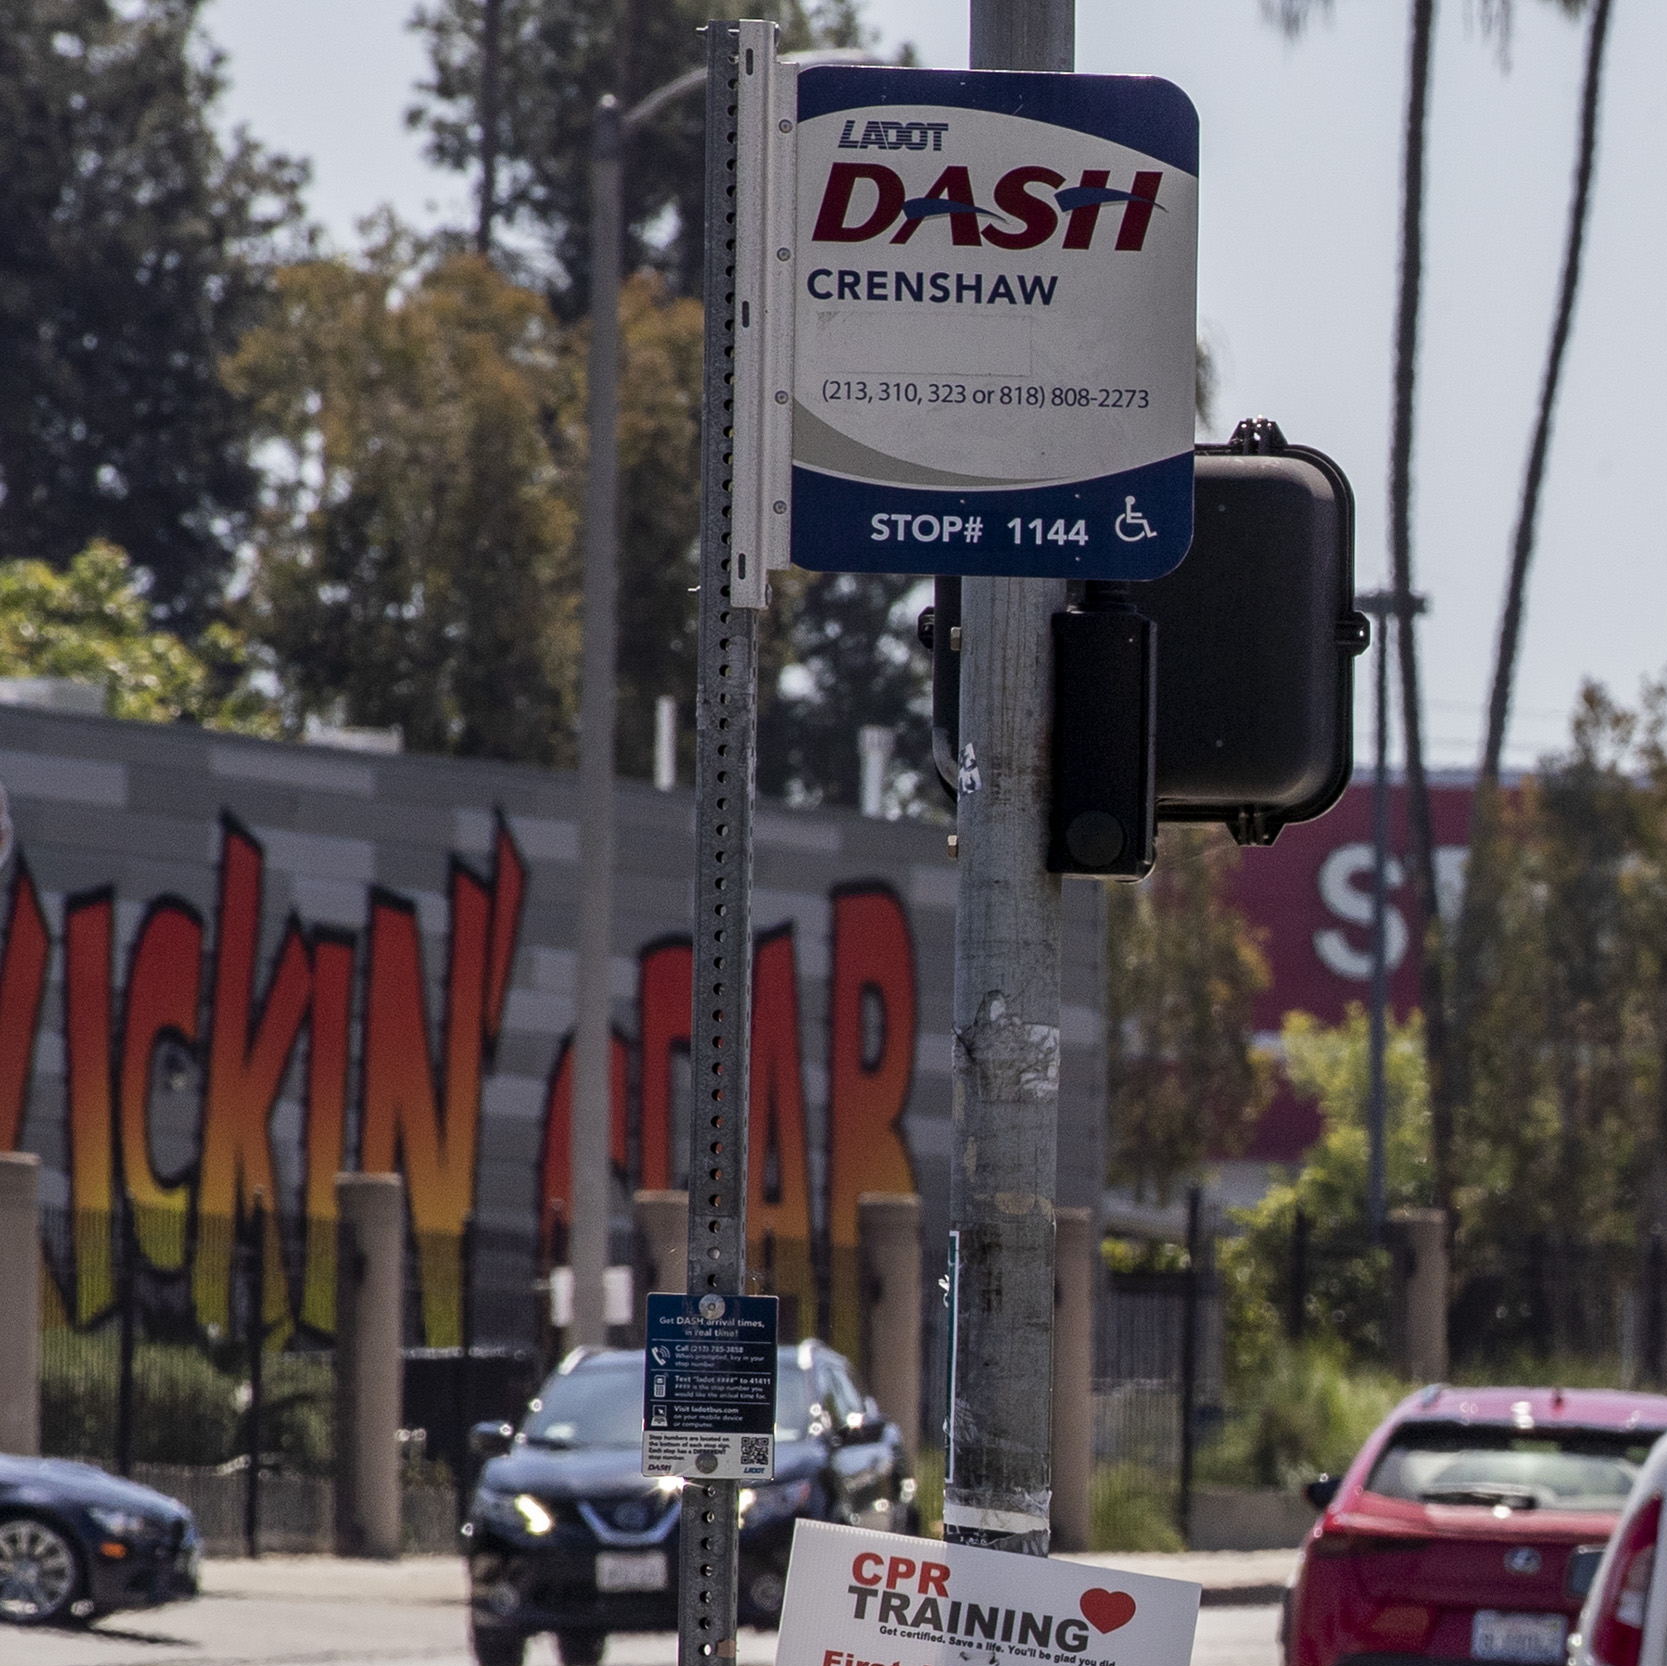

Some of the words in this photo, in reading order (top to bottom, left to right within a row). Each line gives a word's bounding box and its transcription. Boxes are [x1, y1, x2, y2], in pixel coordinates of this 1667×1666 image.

[838, 120, 949, 152] LADOT
[812, 162, 1166, 251] DASH
[807, 268, 1058, 306] CRENSHAW
[822, 380, 874, 405] (213,
[878, 381, 924, 405] 310,
[928, 383, 967, 403] 323
[972, 389, 994, 404] or
[999, 384, 1046, 408] 818)
[1050, 387, 1150, 409] 808-2273
[870, 513, 983, 544] STOP#
[1007, 517, 1089, 546] 1144
[659, 1316, 674, 1325] Get
[676, 1316, 704, 1326] DASH
[706, 1317, 735, 1327] arrival
[737, 1318, 765, 1328] times,
[694, 1328, 712, 1337] real
[714, 1329, 738, 1337] time!
[675, 1344, 689, 1352] Call
[674, 1375, 691, 1383] Text
[673, 1404, 690, 1413] Visit
[691, 1405, 740, 1414] ladotbus.com
[647, 1463, 672, 1472] DASH
[852, 1552, 951, 1599] CPR
[847, 1584, 1090, 1653] TRAINING
[879, 1625, 898, 1638] Get
[899, 1627, 947, 1645] certified.
[948, 1636, 974, 1650] Save
[976, 1641, 984, 1651] a
[985, 1640, 1005, 1654] life.
[1007, 1644, 1037, 1659] You'll
[1038, 1649, 1052, 1661] be
[1053, 1651, 1076, 1666] glad
